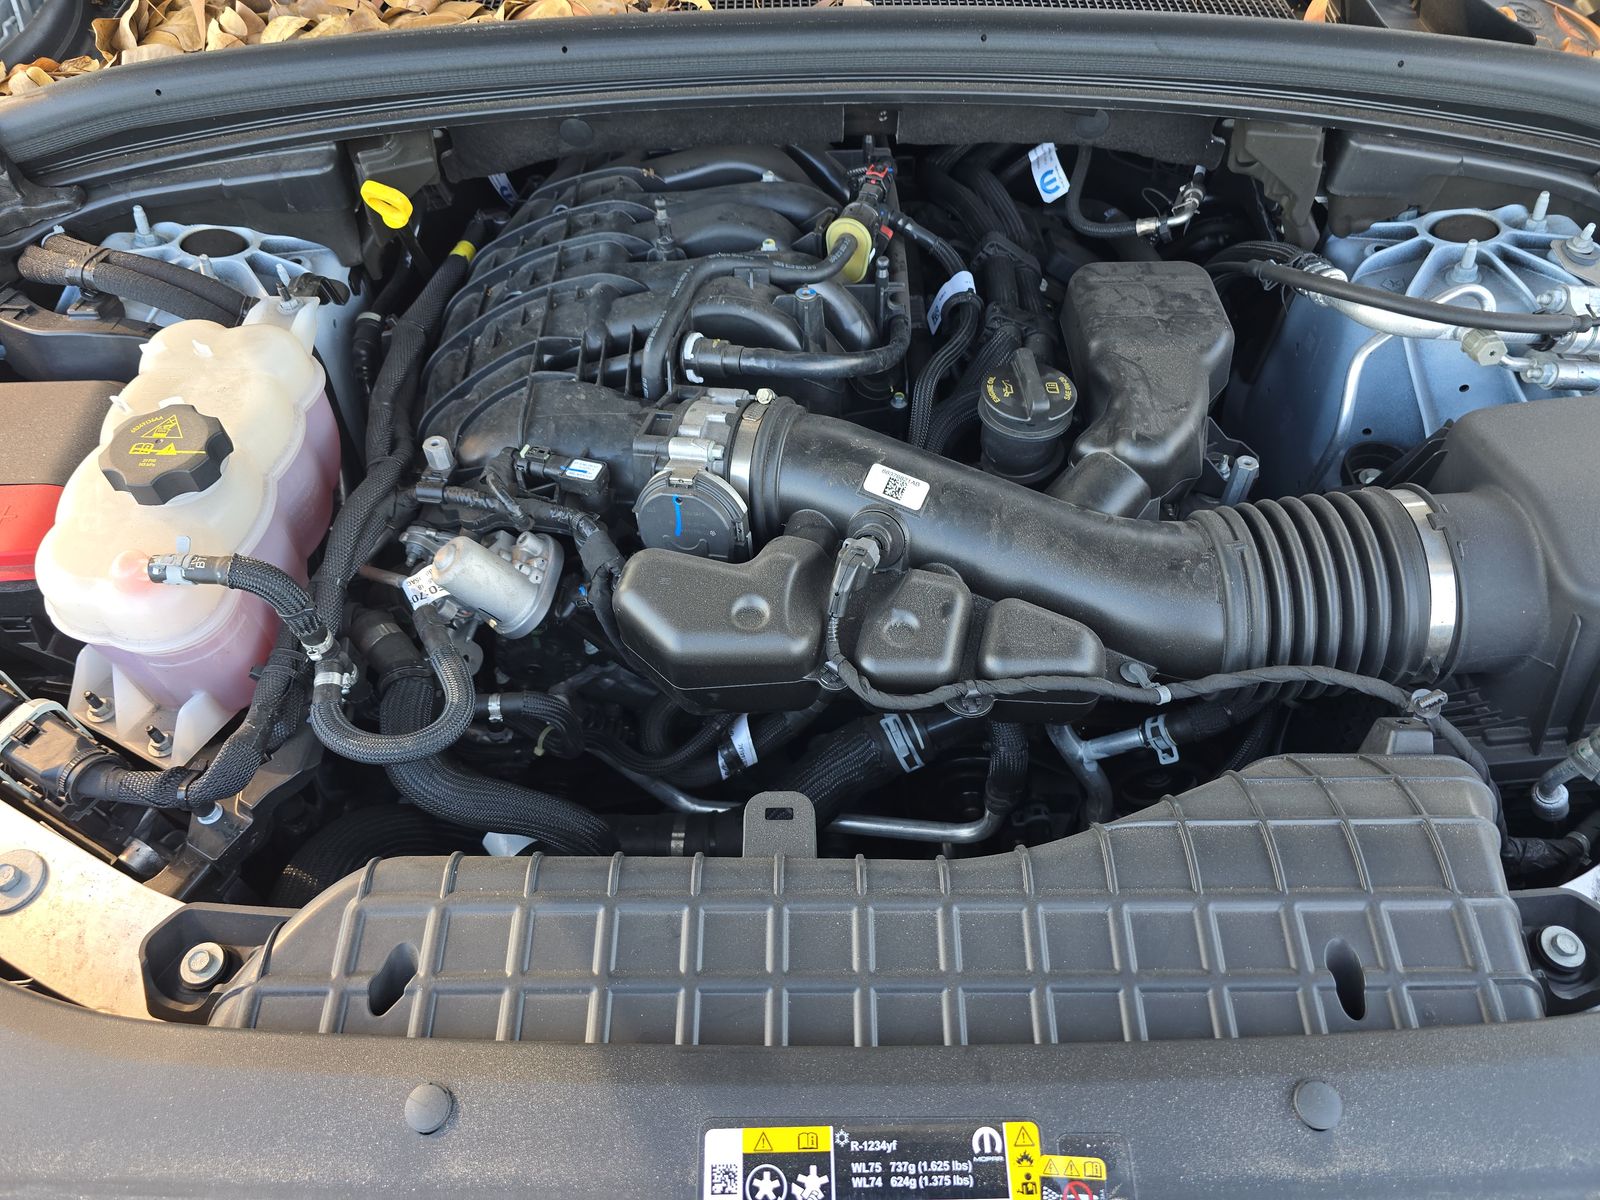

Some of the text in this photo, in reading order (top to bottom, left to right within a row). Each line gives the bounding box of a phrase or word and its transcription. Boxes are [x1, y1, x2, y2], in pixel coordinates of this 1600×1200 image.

[986, 376, 1001, 404] ENGINE OIL
[850, 1140, 898, 1153] R-1234yf
[851, 1160, 973, 1174] WL75 737g (1.625 lbs)
[852, 1175, 974, 1189] WL74 624g (1.375 lbs)
